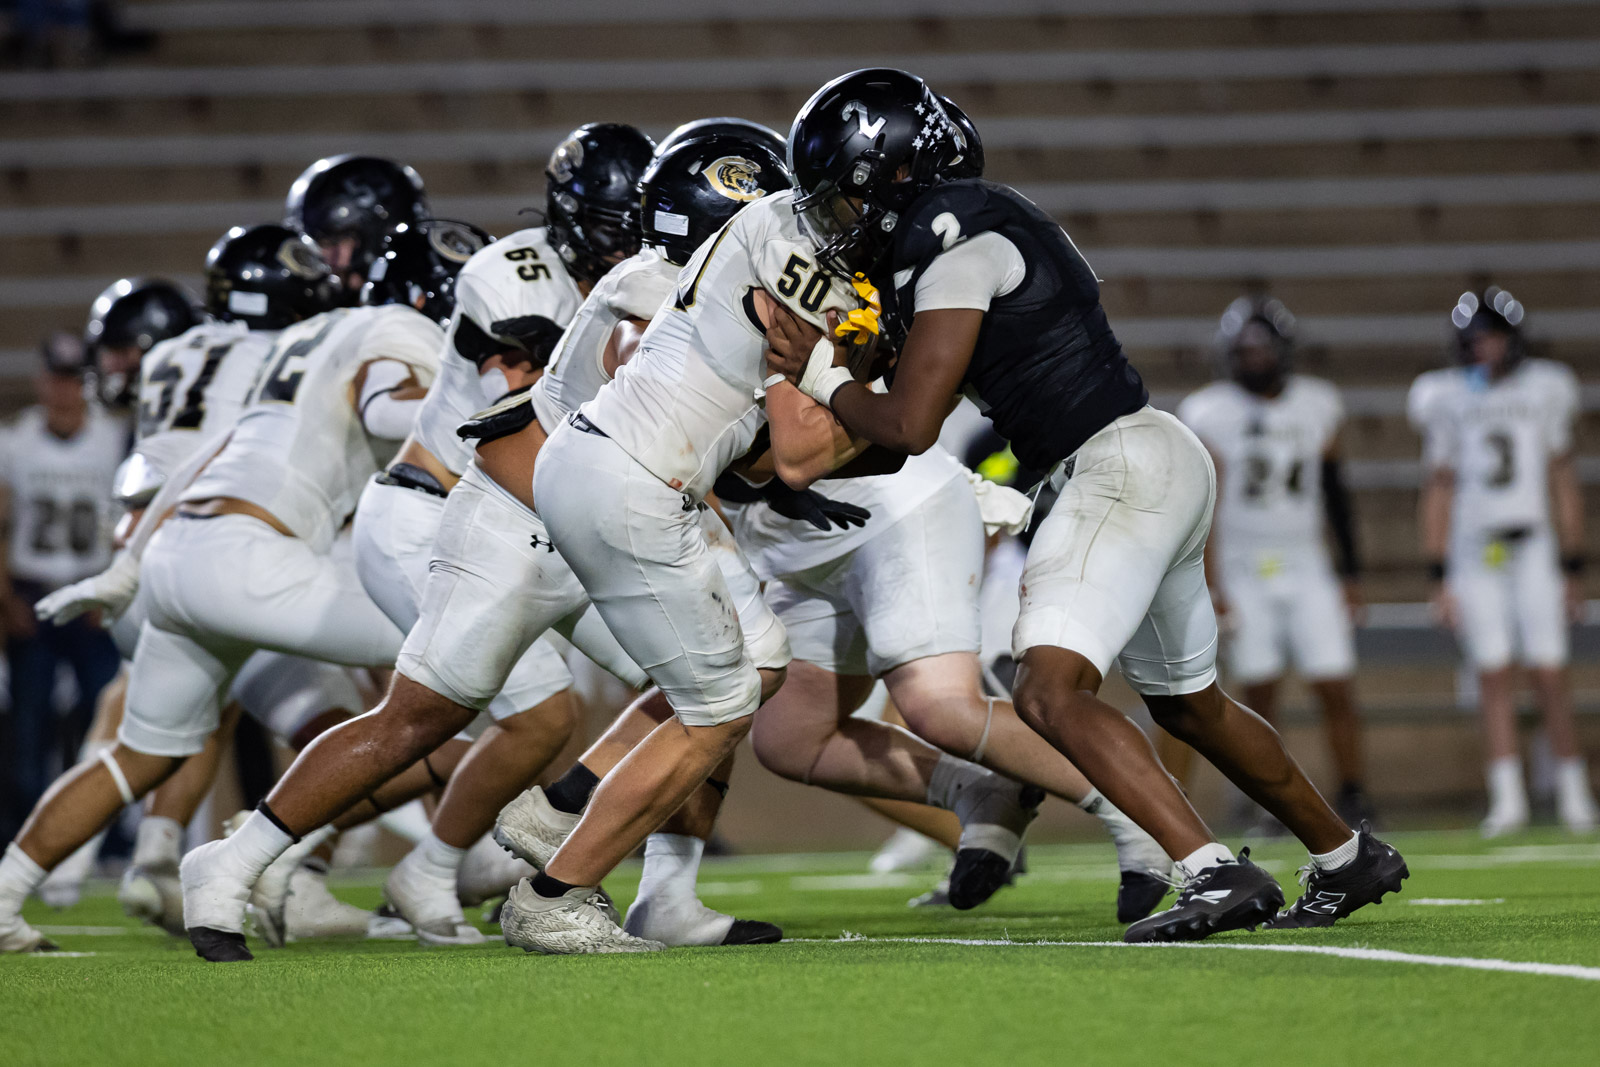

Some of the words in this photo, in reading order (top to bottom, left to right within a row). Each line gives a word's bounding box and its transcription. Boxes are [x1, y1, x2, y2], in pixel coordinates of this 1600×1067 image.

[841, 101, 888, 140] 2
[931, 211, 968, 251] 2
[504, 246, 553, 282] 65
[778, 251, 832, 313] 50
